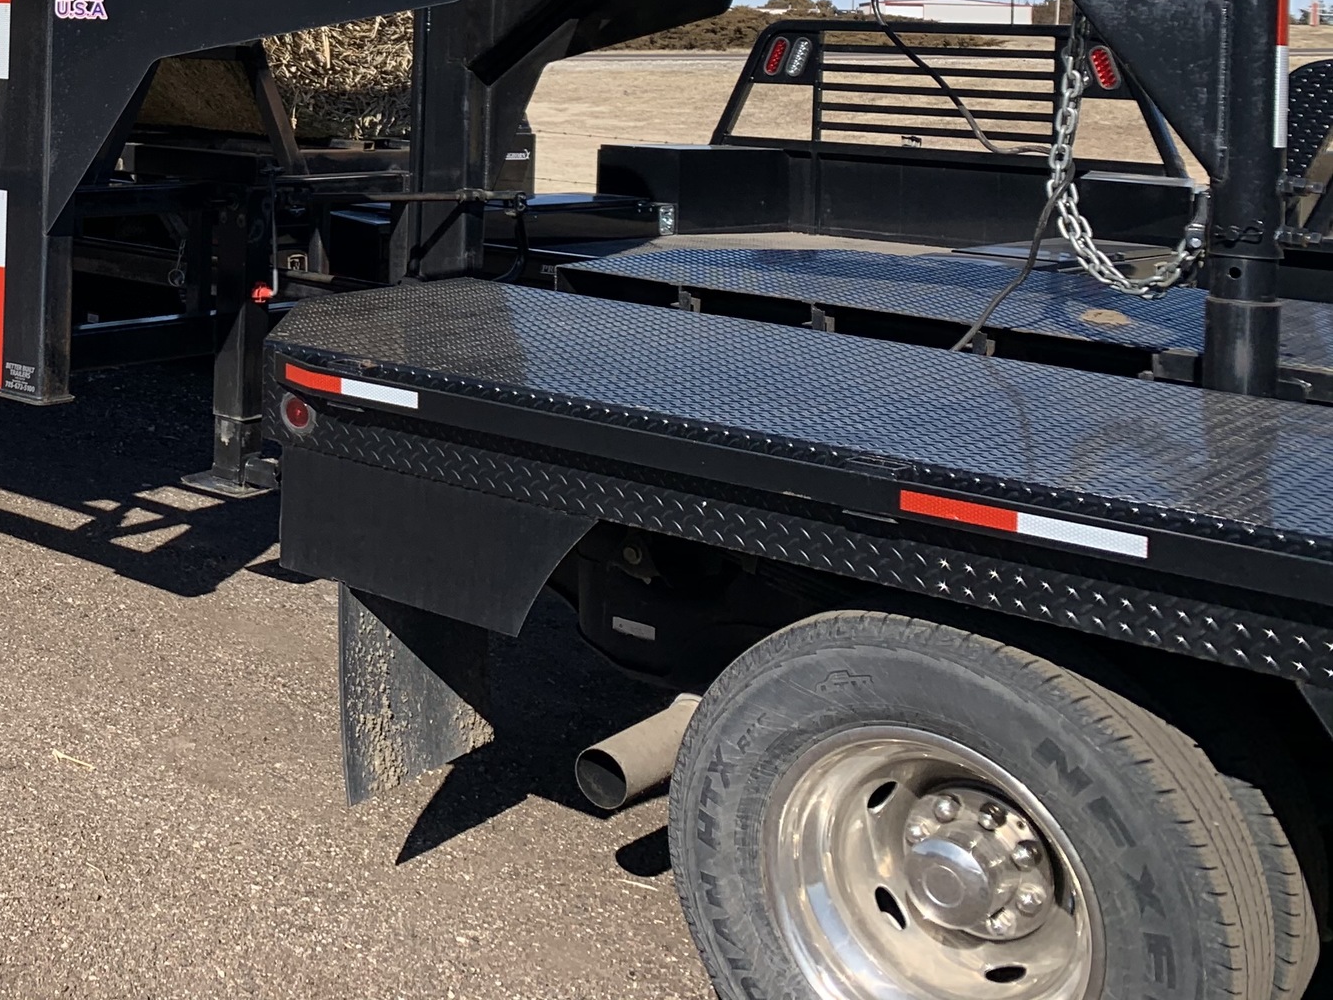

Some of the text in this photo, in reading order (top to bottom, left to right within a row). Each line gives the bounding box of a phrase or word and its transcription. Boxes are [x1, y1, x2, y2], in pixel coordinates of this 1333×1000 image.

[56, 0, 108, 19] U.S.A
[9, 369, 31, 380] TRAILERS
[696, 743, 738, 851] HTX
[1030, 737, 1178, 1000] NEXE
